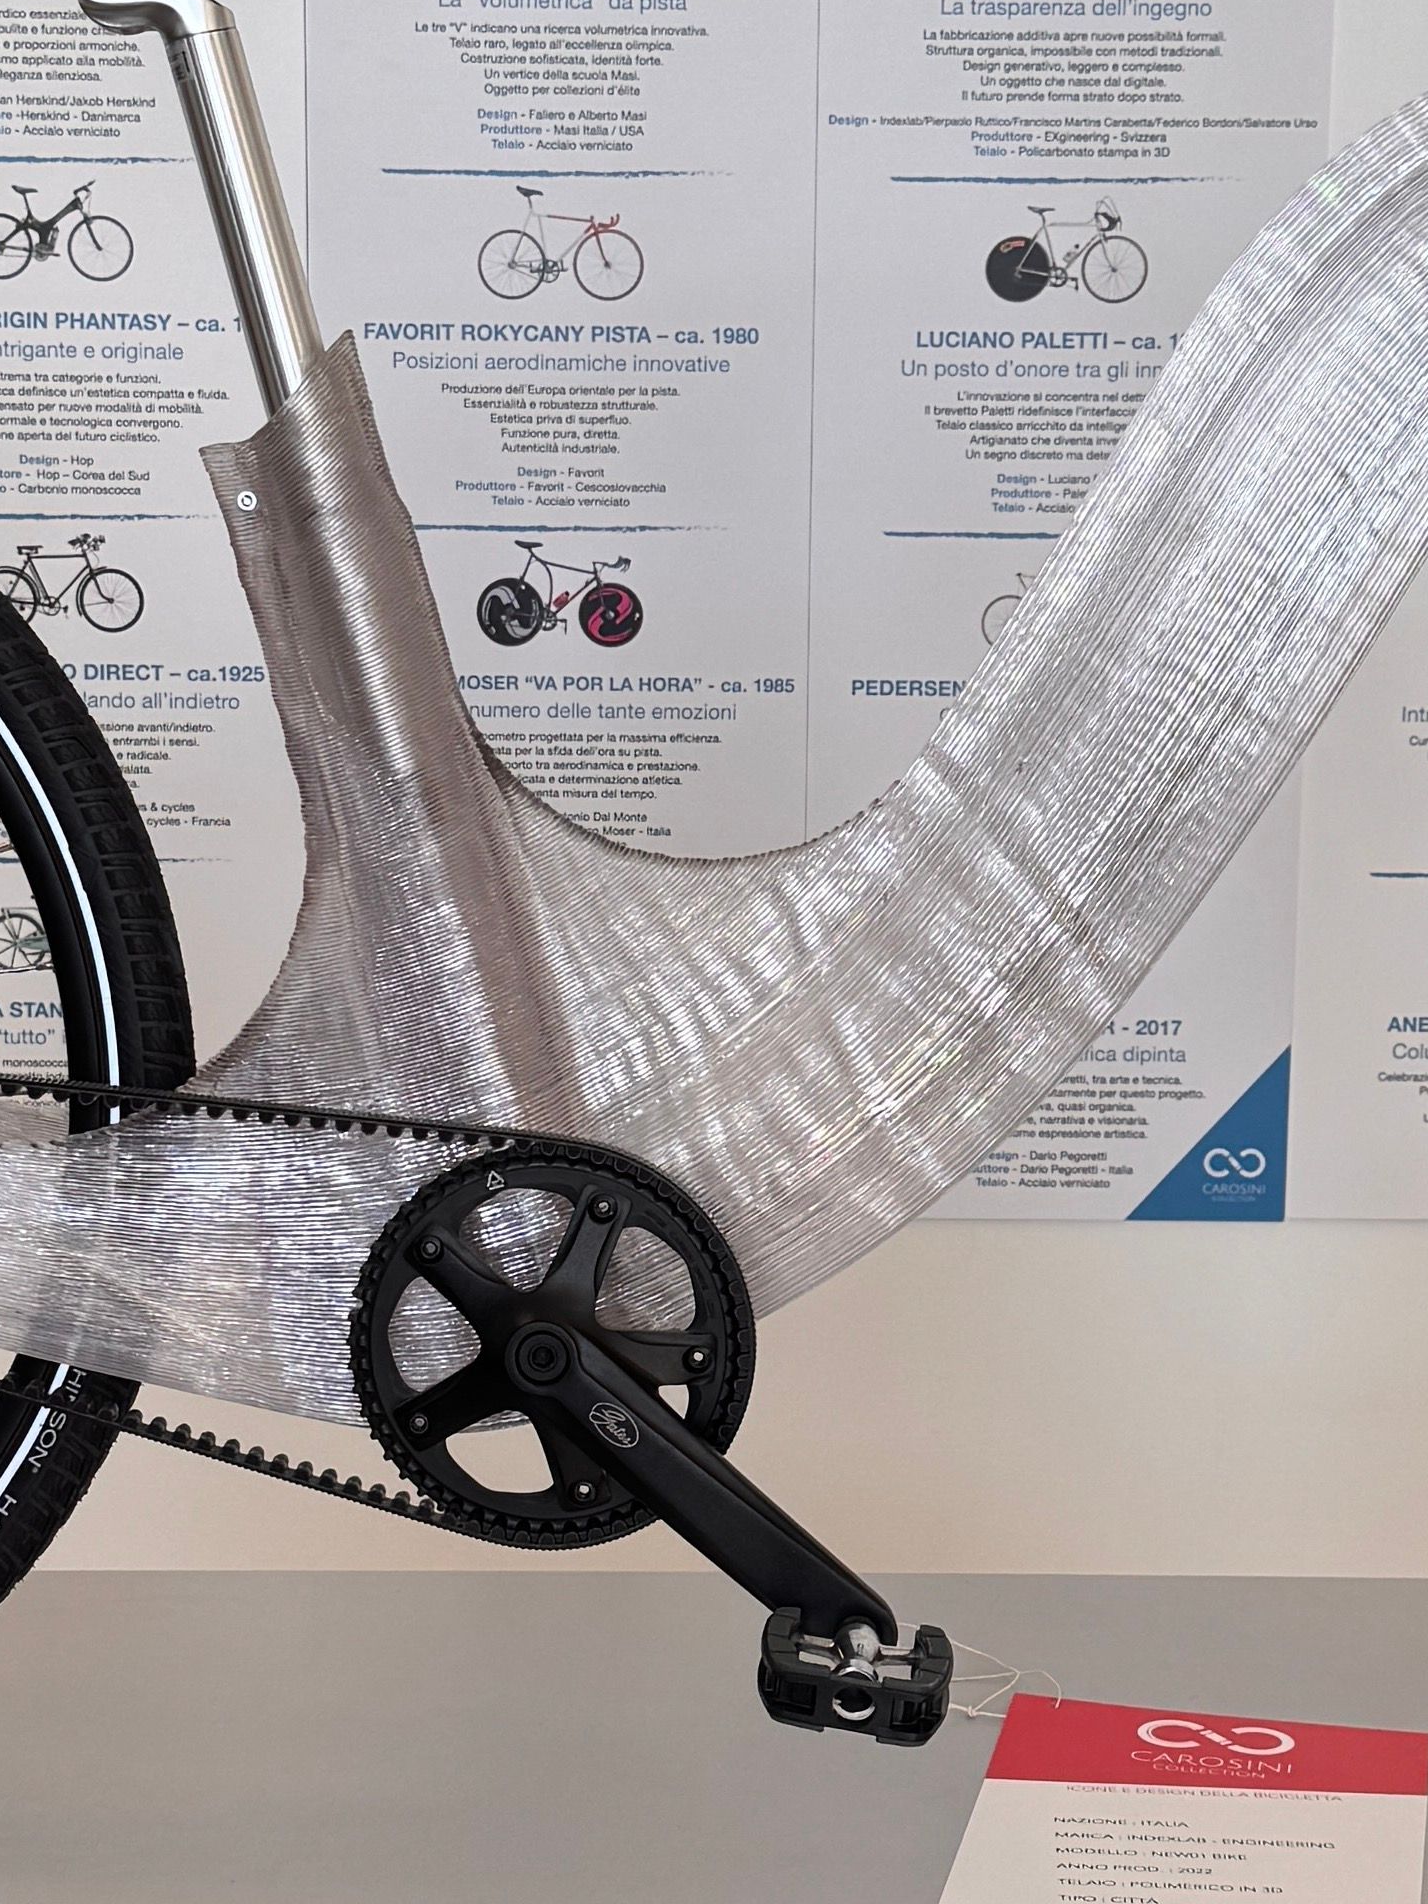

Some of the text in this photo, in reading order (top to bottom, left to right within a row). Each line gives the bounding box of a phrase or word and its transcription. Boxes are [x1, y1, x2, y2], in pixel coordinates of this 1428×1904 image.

[83, 345, 95, 359] e
[101, 341, 184, 364] originale
[392, 351, 731, 373] Posizioni aerodinamiche innovative
[546, 702, 737, 721] delle tante emozioni
[1135, 1019, 1183, 1036] 2017
[1122, 1045, 1187, 1066] dipinta
[1201, 1183, 1266, 1198] CAROSINI
[1131, 1750, 1292, 1774] CAROSINI
[1153, 1763, 1266, 1779] COLLECTION
